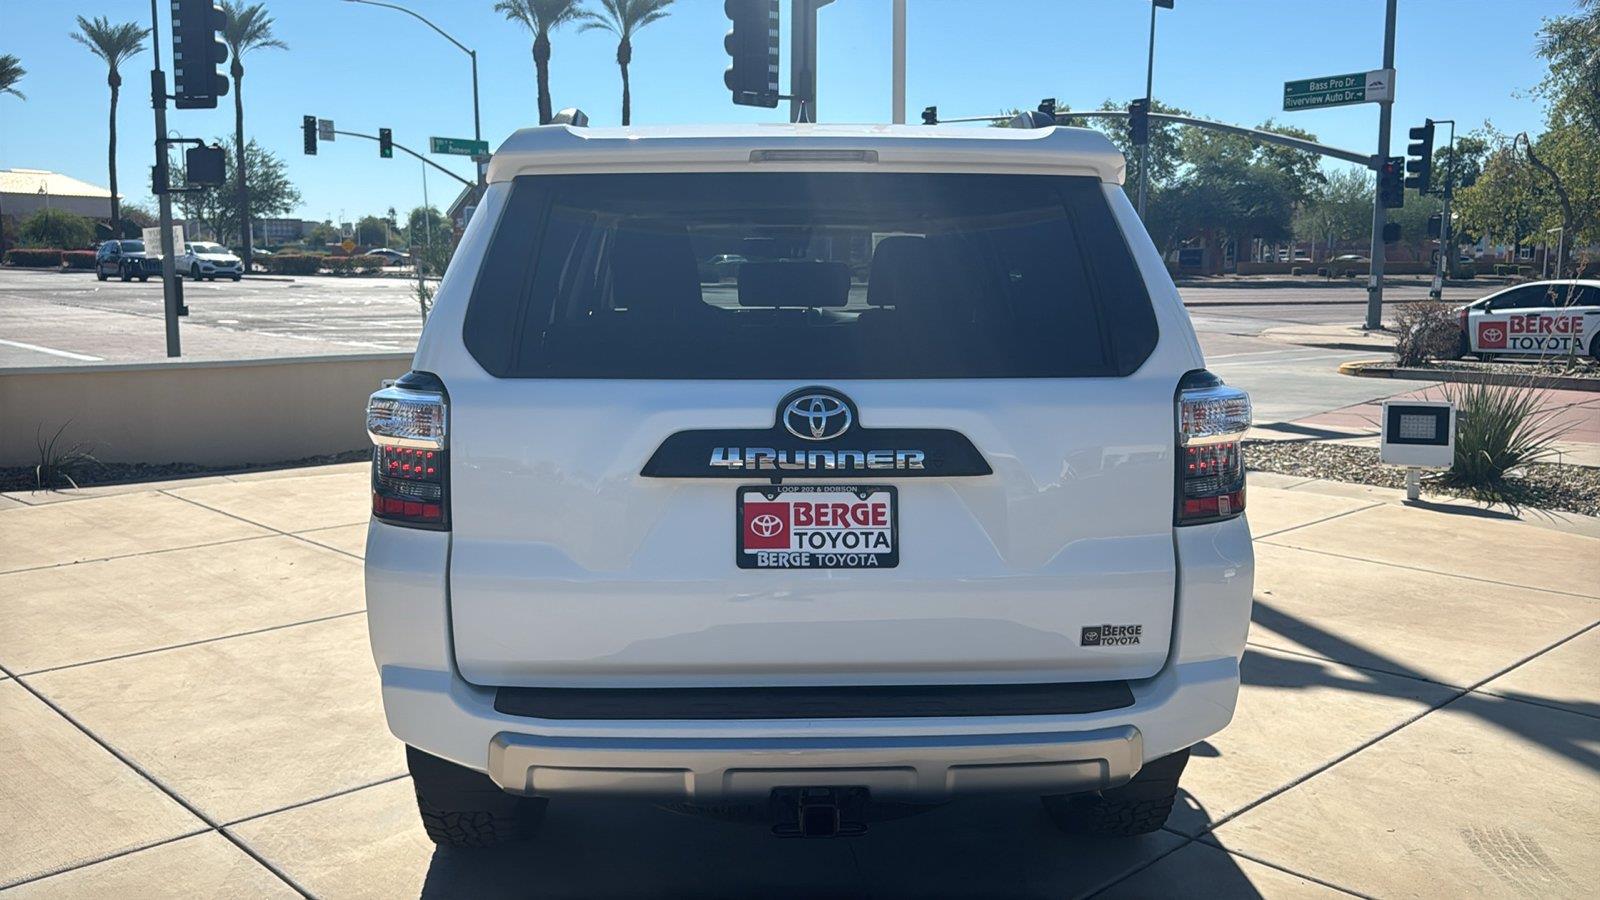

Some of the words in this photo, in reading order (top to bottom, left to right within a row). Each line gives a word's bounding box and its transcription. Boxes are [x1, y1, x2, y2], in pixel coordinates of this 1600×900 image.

[1309, 81, 1328, 91] Bass
[1329, 79, 1343, 88] Pro
[1345, 77, 1357, 86] Dr.
[1285, 94, 1323, 107] Riverview
[1324, 93, 1343, 103] Auto
[1510, 315, 1584, 334] BERGE
[1509, 337, 1584, 350] TOYOTA
[793, 502, 887, 528] BERGE
[793, 531, 890, 549] TOYOTA
[757, 551, 811, 567] BERGE
[815, 554, 878, 566] TOYOTA
[1102, 624, 1142, 636] BERGE
[1101, 636, 1140, 645] TOYOTA
